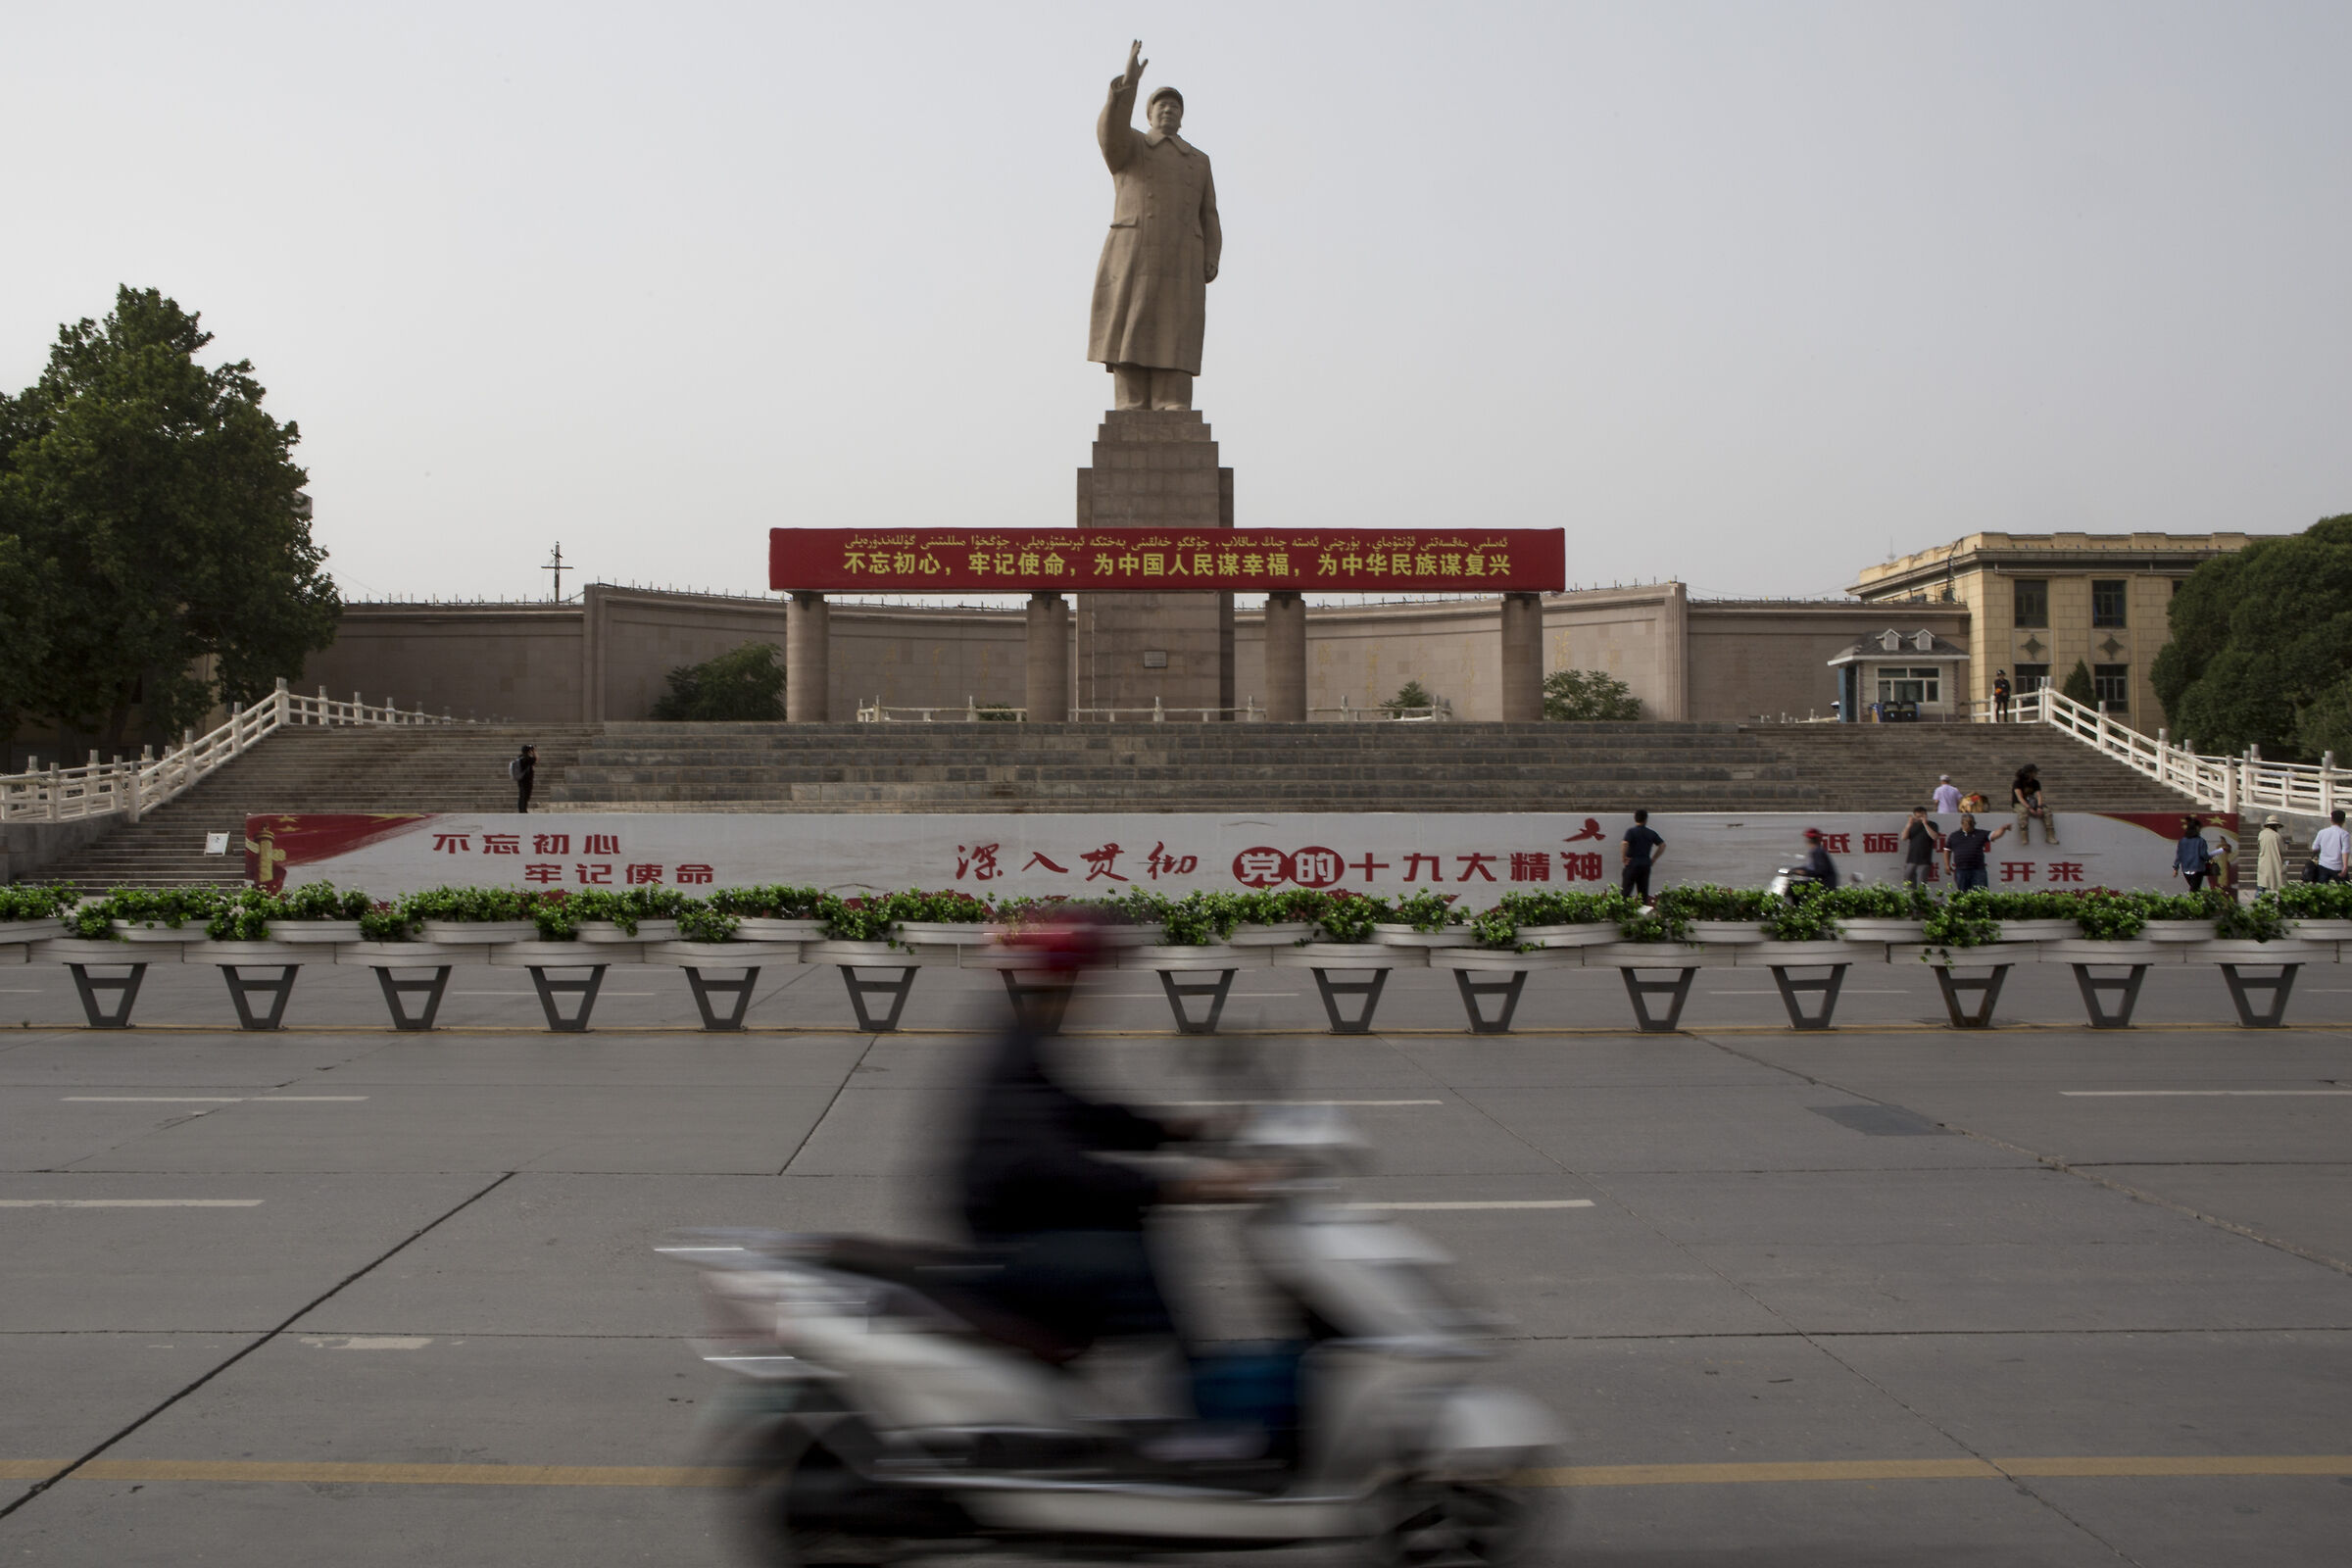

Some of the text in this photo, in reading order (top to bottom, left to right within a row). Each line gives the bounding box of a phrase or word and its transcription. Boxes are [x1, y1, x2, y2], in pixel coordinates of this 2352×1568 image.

[432, 834, 619, 855] 不忘初心
[525, 863, 715, 884] 牢记使命
